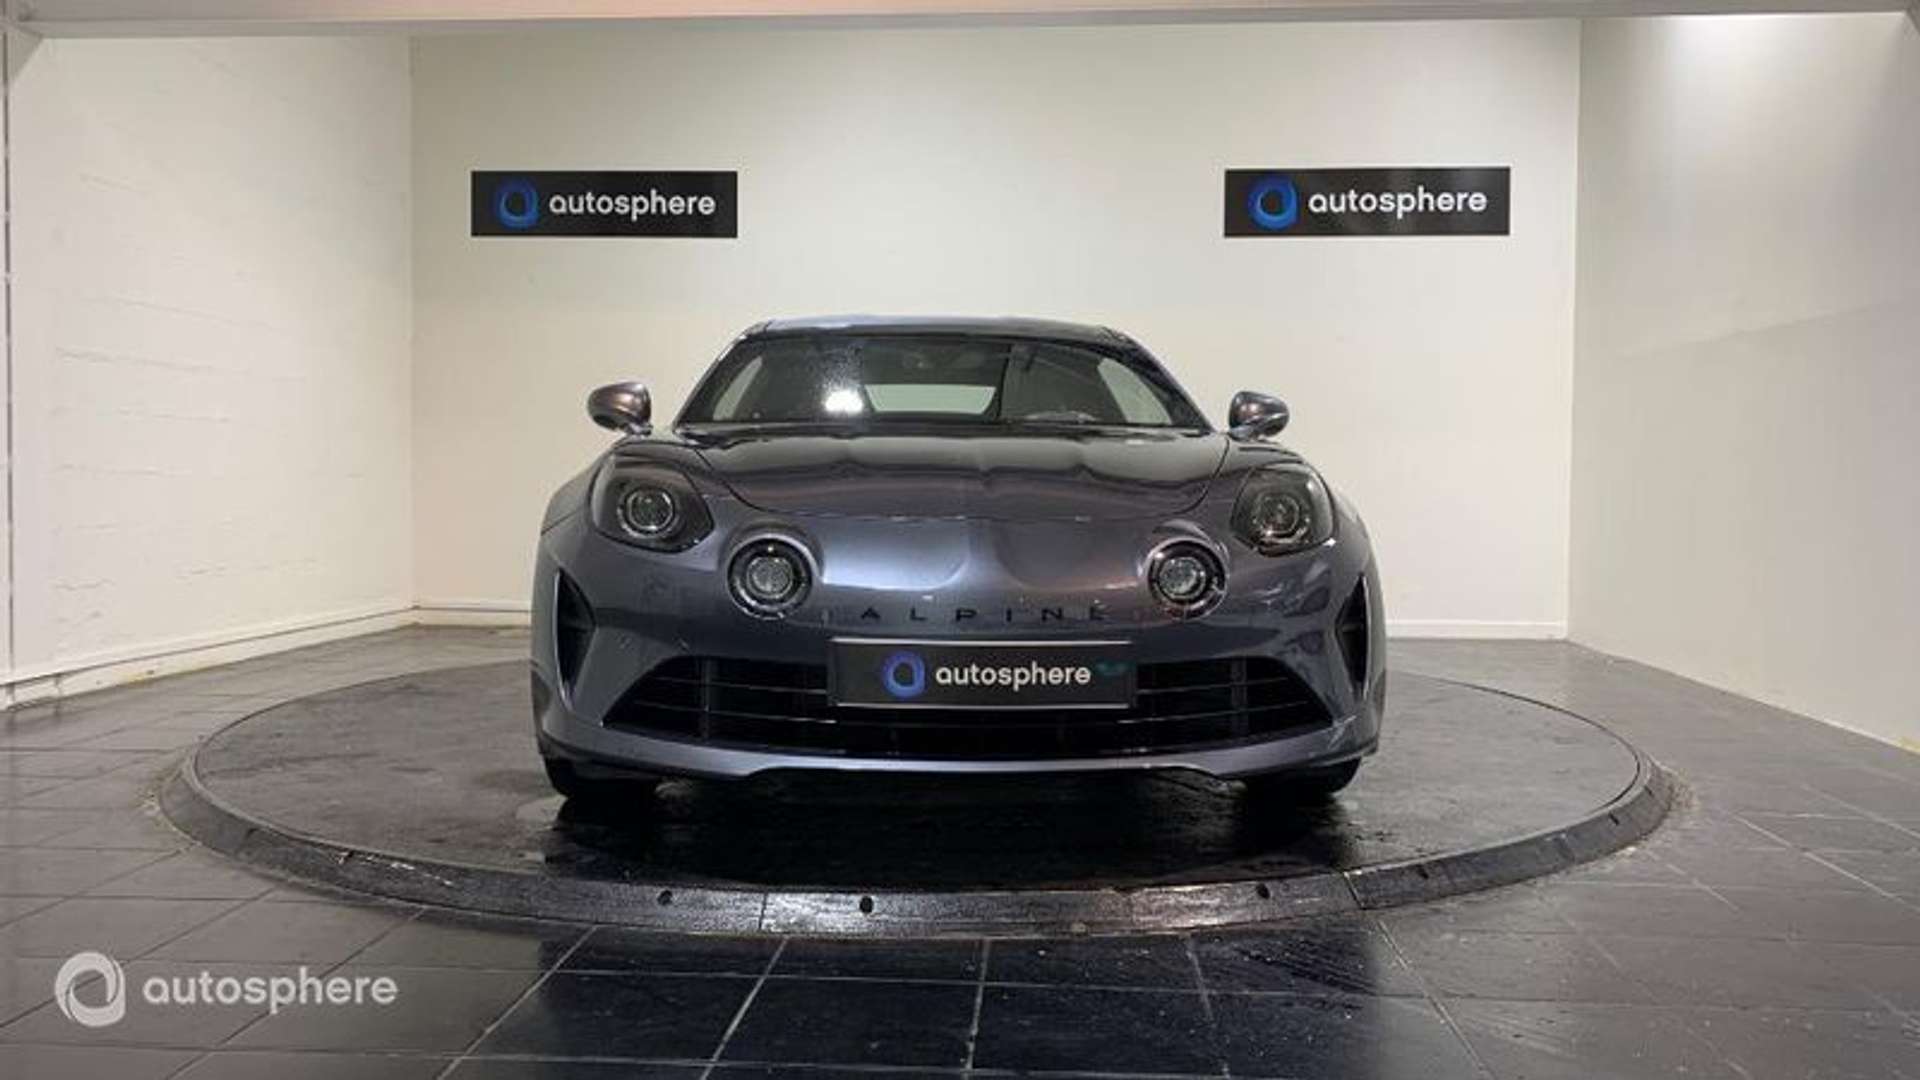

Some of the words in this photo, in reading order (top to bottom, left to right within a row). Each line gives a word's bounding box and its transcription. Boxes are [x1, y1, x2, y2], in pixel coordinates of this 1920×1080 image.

[549, 188, 716, 221] autosphere
[1308, 186, 1488, 219] autosphere
[860, 606, 1106, 622] ALPINE
[935, 661, 1092, 691] autosphere
